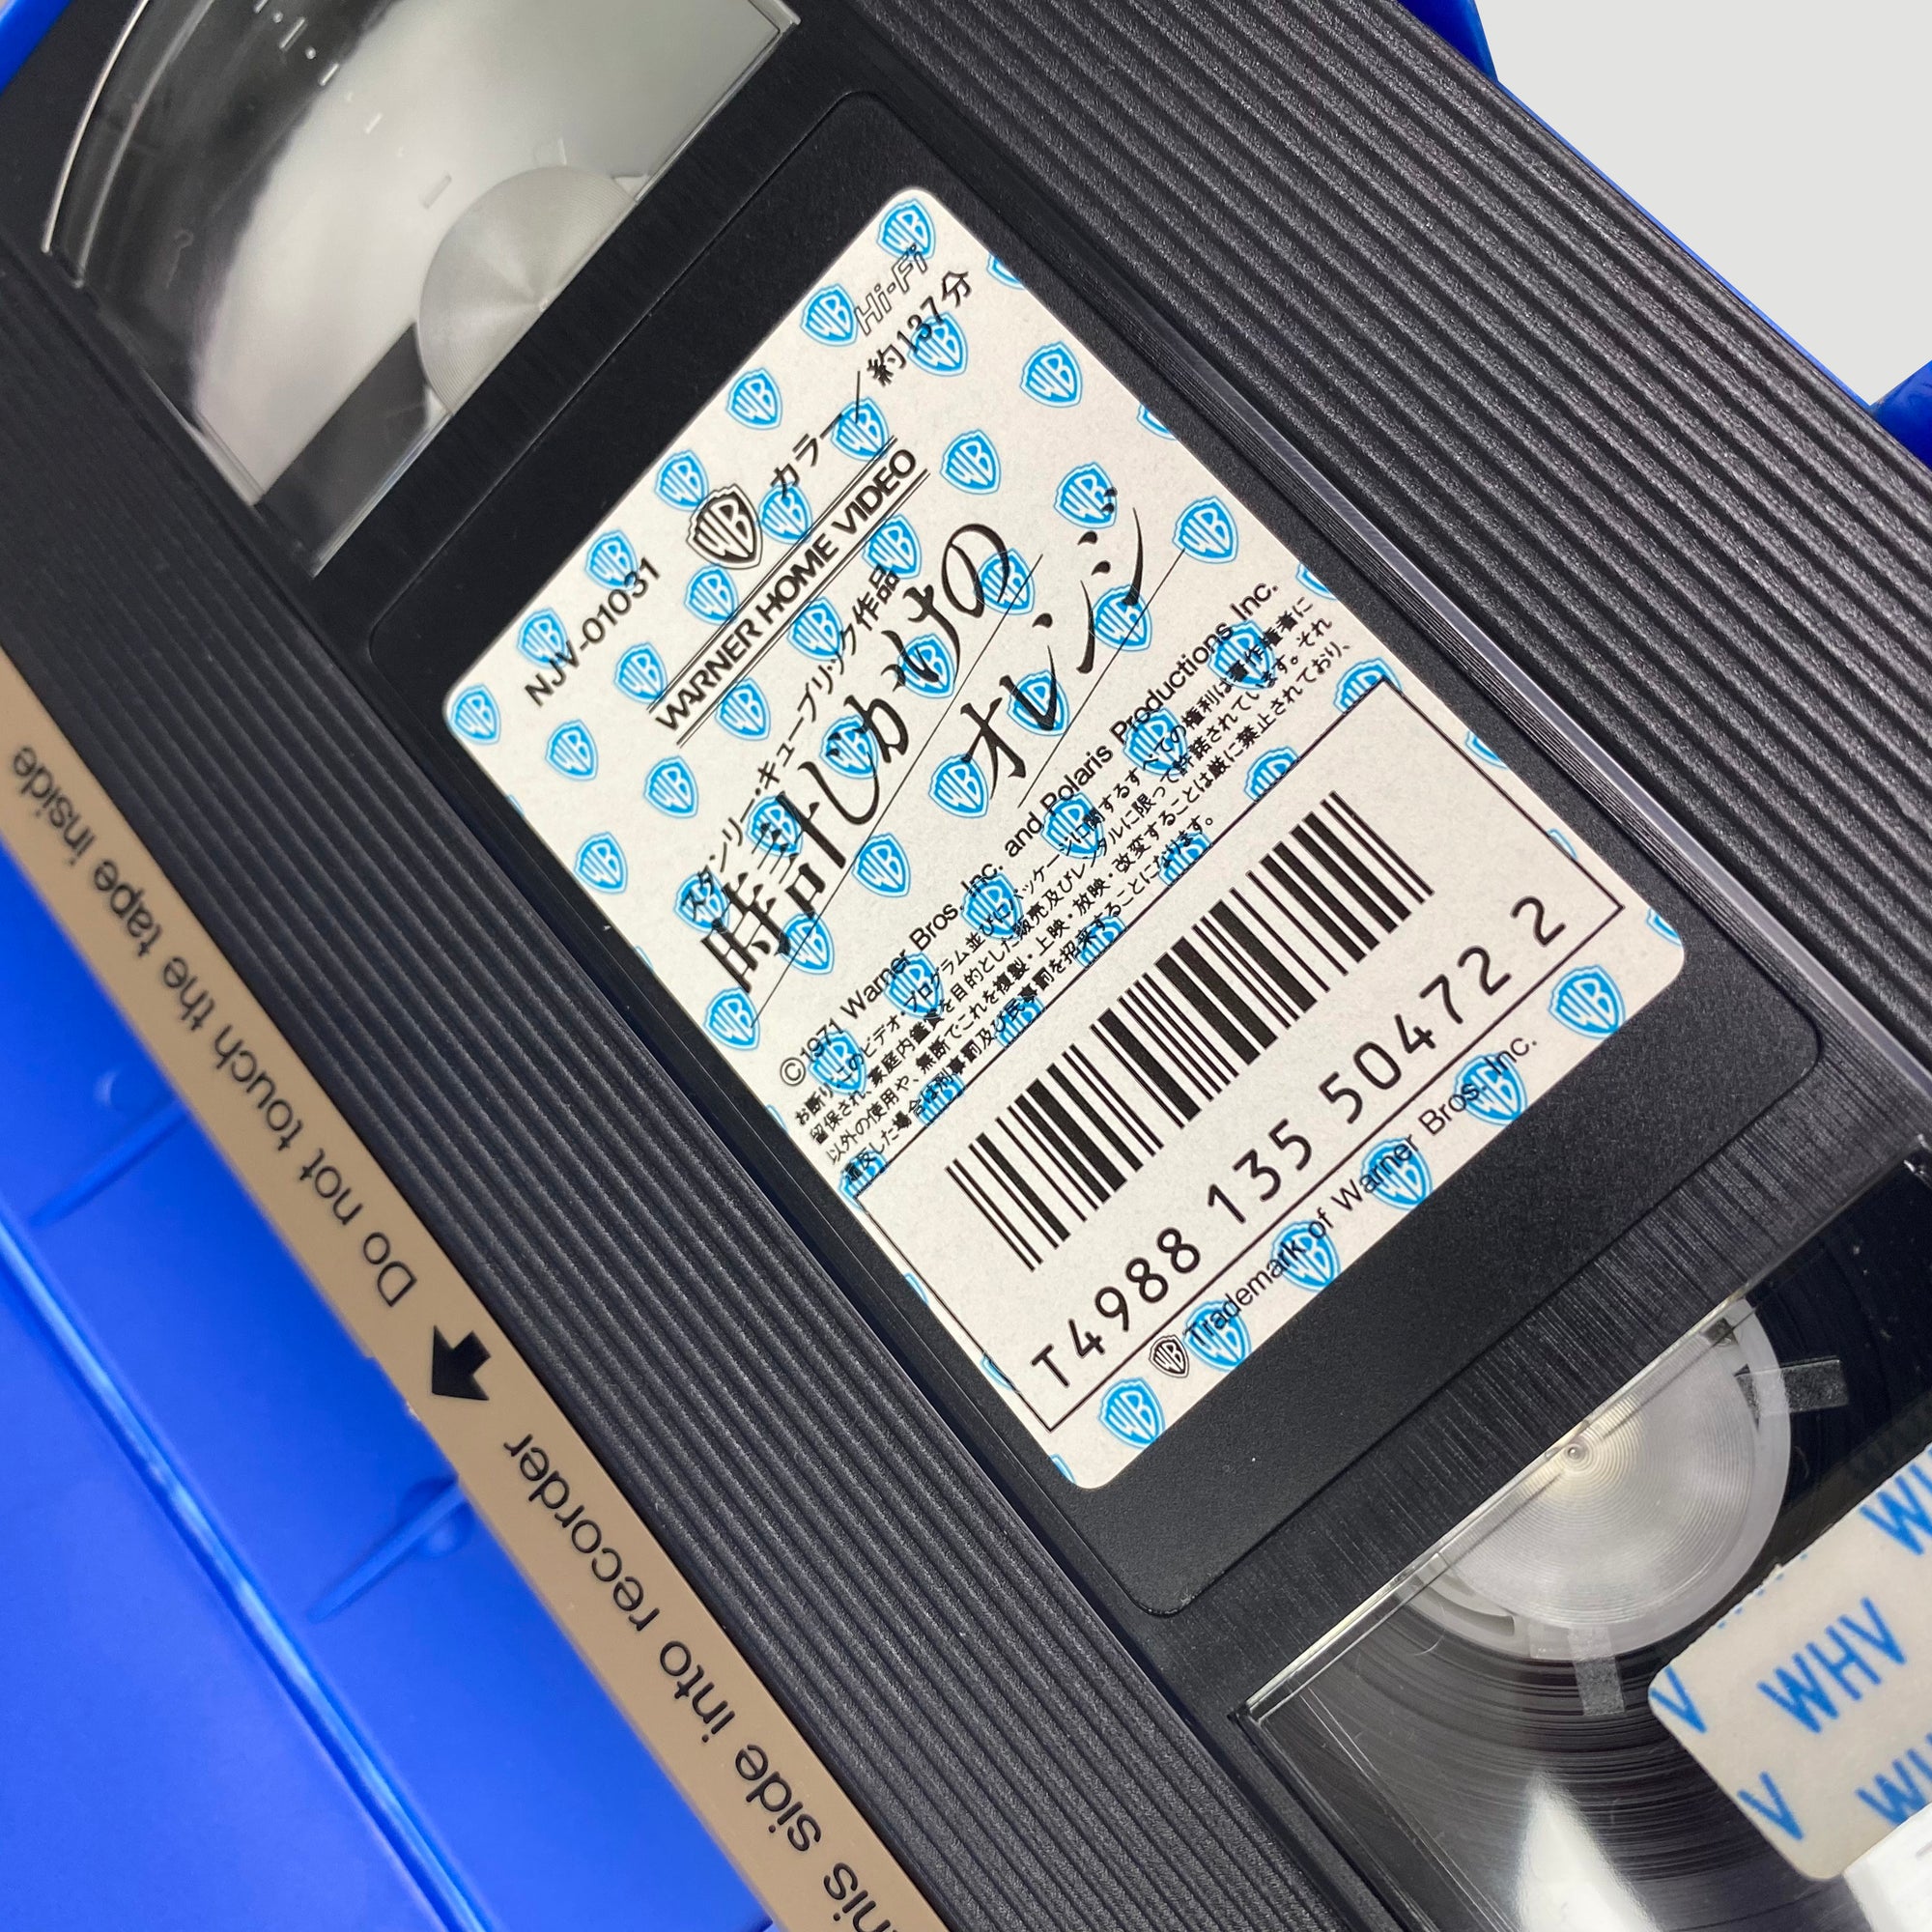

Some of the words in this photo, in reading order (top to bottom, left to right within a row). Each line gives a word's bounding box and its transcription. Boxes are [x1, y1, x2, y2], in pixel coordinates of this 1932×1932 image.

[853, 242, 928, 336] Hi-Fi
[524, 556, 660, 707] NJV-01031
[655, 618, 763, 730] WARNER
[754, 532, 839, 625] HOME
[831, 448, 917, 534] VIDEO
[959, 486, 1141, 800] オレンジ
[12, 745, 95, 866] inside
[681, 563, 900, 920] スタンリー・キューブリック作品
[699, 523, 1010, 994] 時計じかけの
[780, 1017, 844, 1087] ©1971
[839, 949, 911, 1019] Warner
[908, 903, 965, 952] Bros.
[960, 863, 1004, 898] Inc.
[1004, 810, 1045, 858] and
[1039, 745, 1114, 817] Polaris
[1109, 622, 1235, 745] Productions
[1230, 582, 1278, 621] Inc.
[95, 858, 161, 957] tape
[162, 956, 214, 1032] the
[213, 1024, 304, 1151] touch
[1031, 1227, 1201, 1387] T4988
[1208, 1119, 1312, 1224] 135
[1319, 946, 1512, 1124] 50472
[1511, 896, 1566, 947] 2
[299, 1147, 362, 1226] not
[1182, 1239, 1306, 1345] Trademark
[1308, 1207, 1334, 1239] of
[1330, 1133, 1419, 1211] Warner
[1417, 1083, 1487, 1136] Bros.
[1484, 1037, 1537, 1075] Inc.
[362, 1231, 417, 1308] Do
[502, 1435, 661, 1633] recorder
[659, 1640, 736, 1744] into
[1757, 1597, 1908, 1734] WHV
[733, 1744, 822, 1852] side
